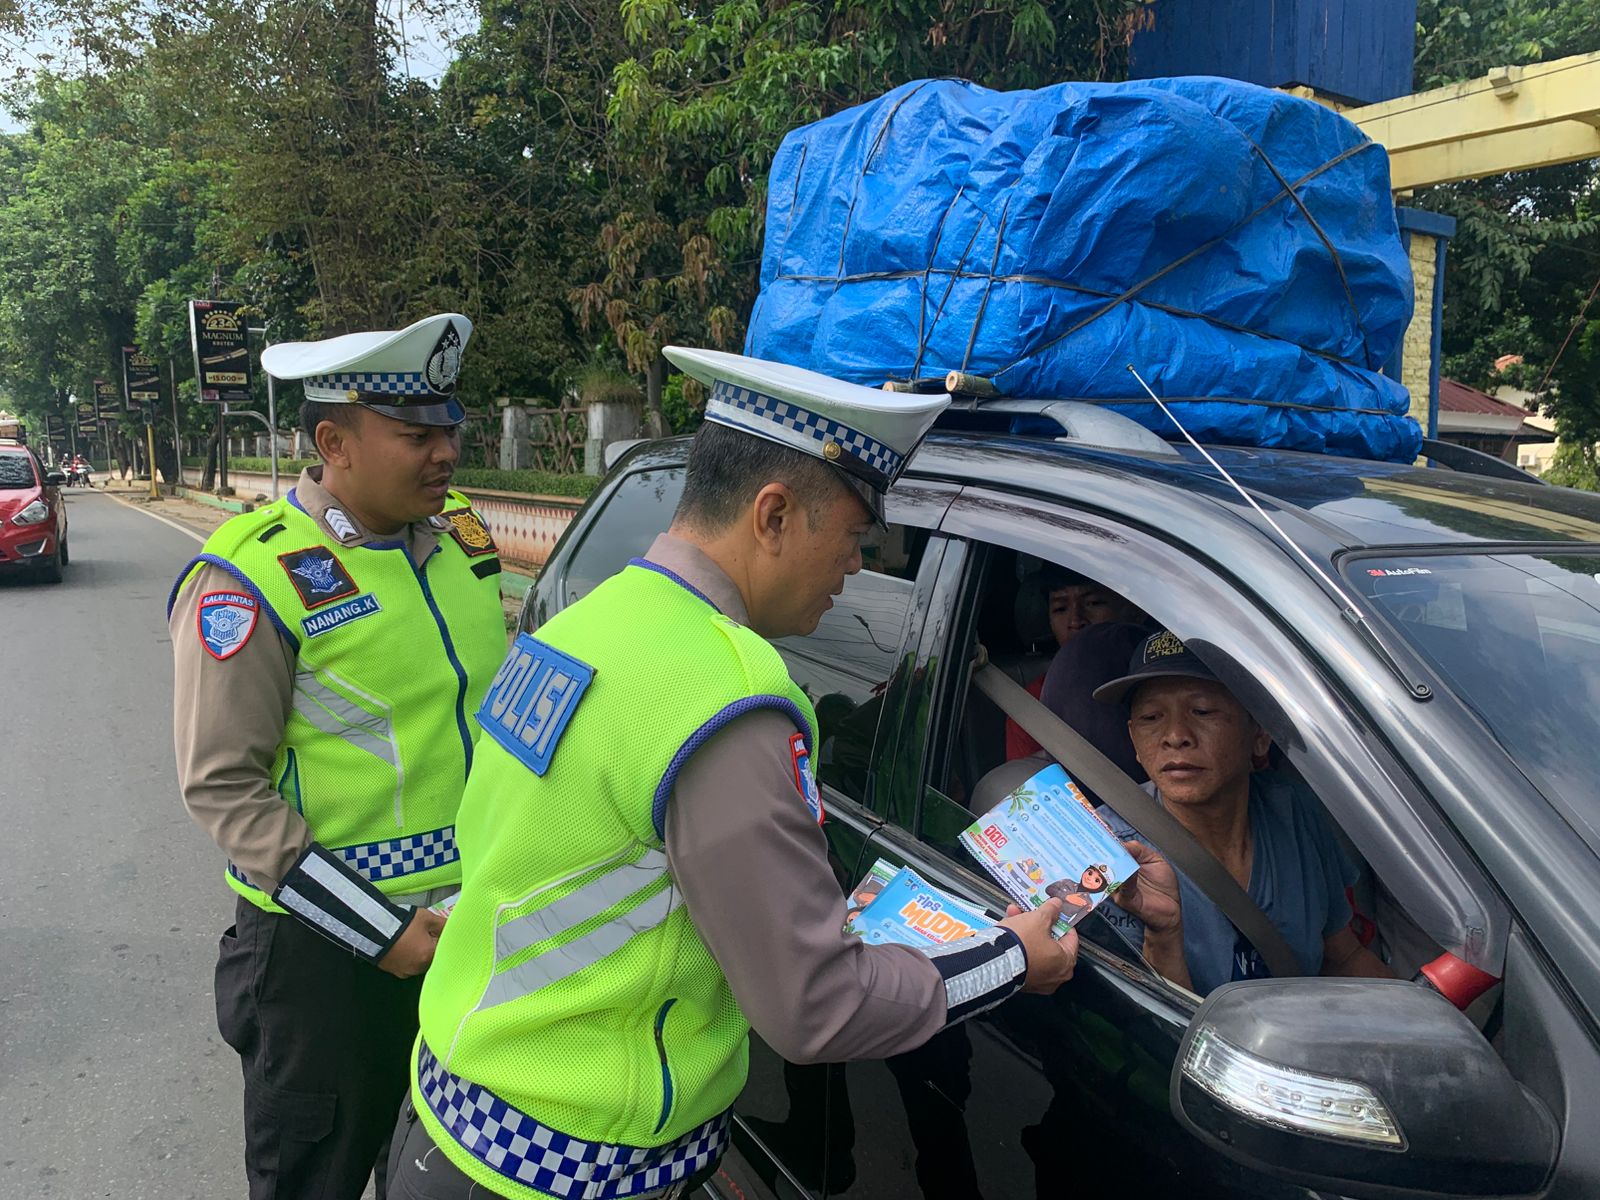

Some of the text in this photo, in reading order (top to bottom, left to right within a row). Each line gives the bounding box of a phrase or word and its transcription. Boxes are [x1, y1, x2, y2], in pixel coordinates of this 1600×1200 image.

[210, 318, 234, 329] 234
[202, 332, 243, 341] MAGNUM
[226, 594, 254, 607] LINTAS
[306, 598, 376, 634] NANANG.K
[481, 643, 581, 758] POLISI
[984, 824, 1008, 849] 110
